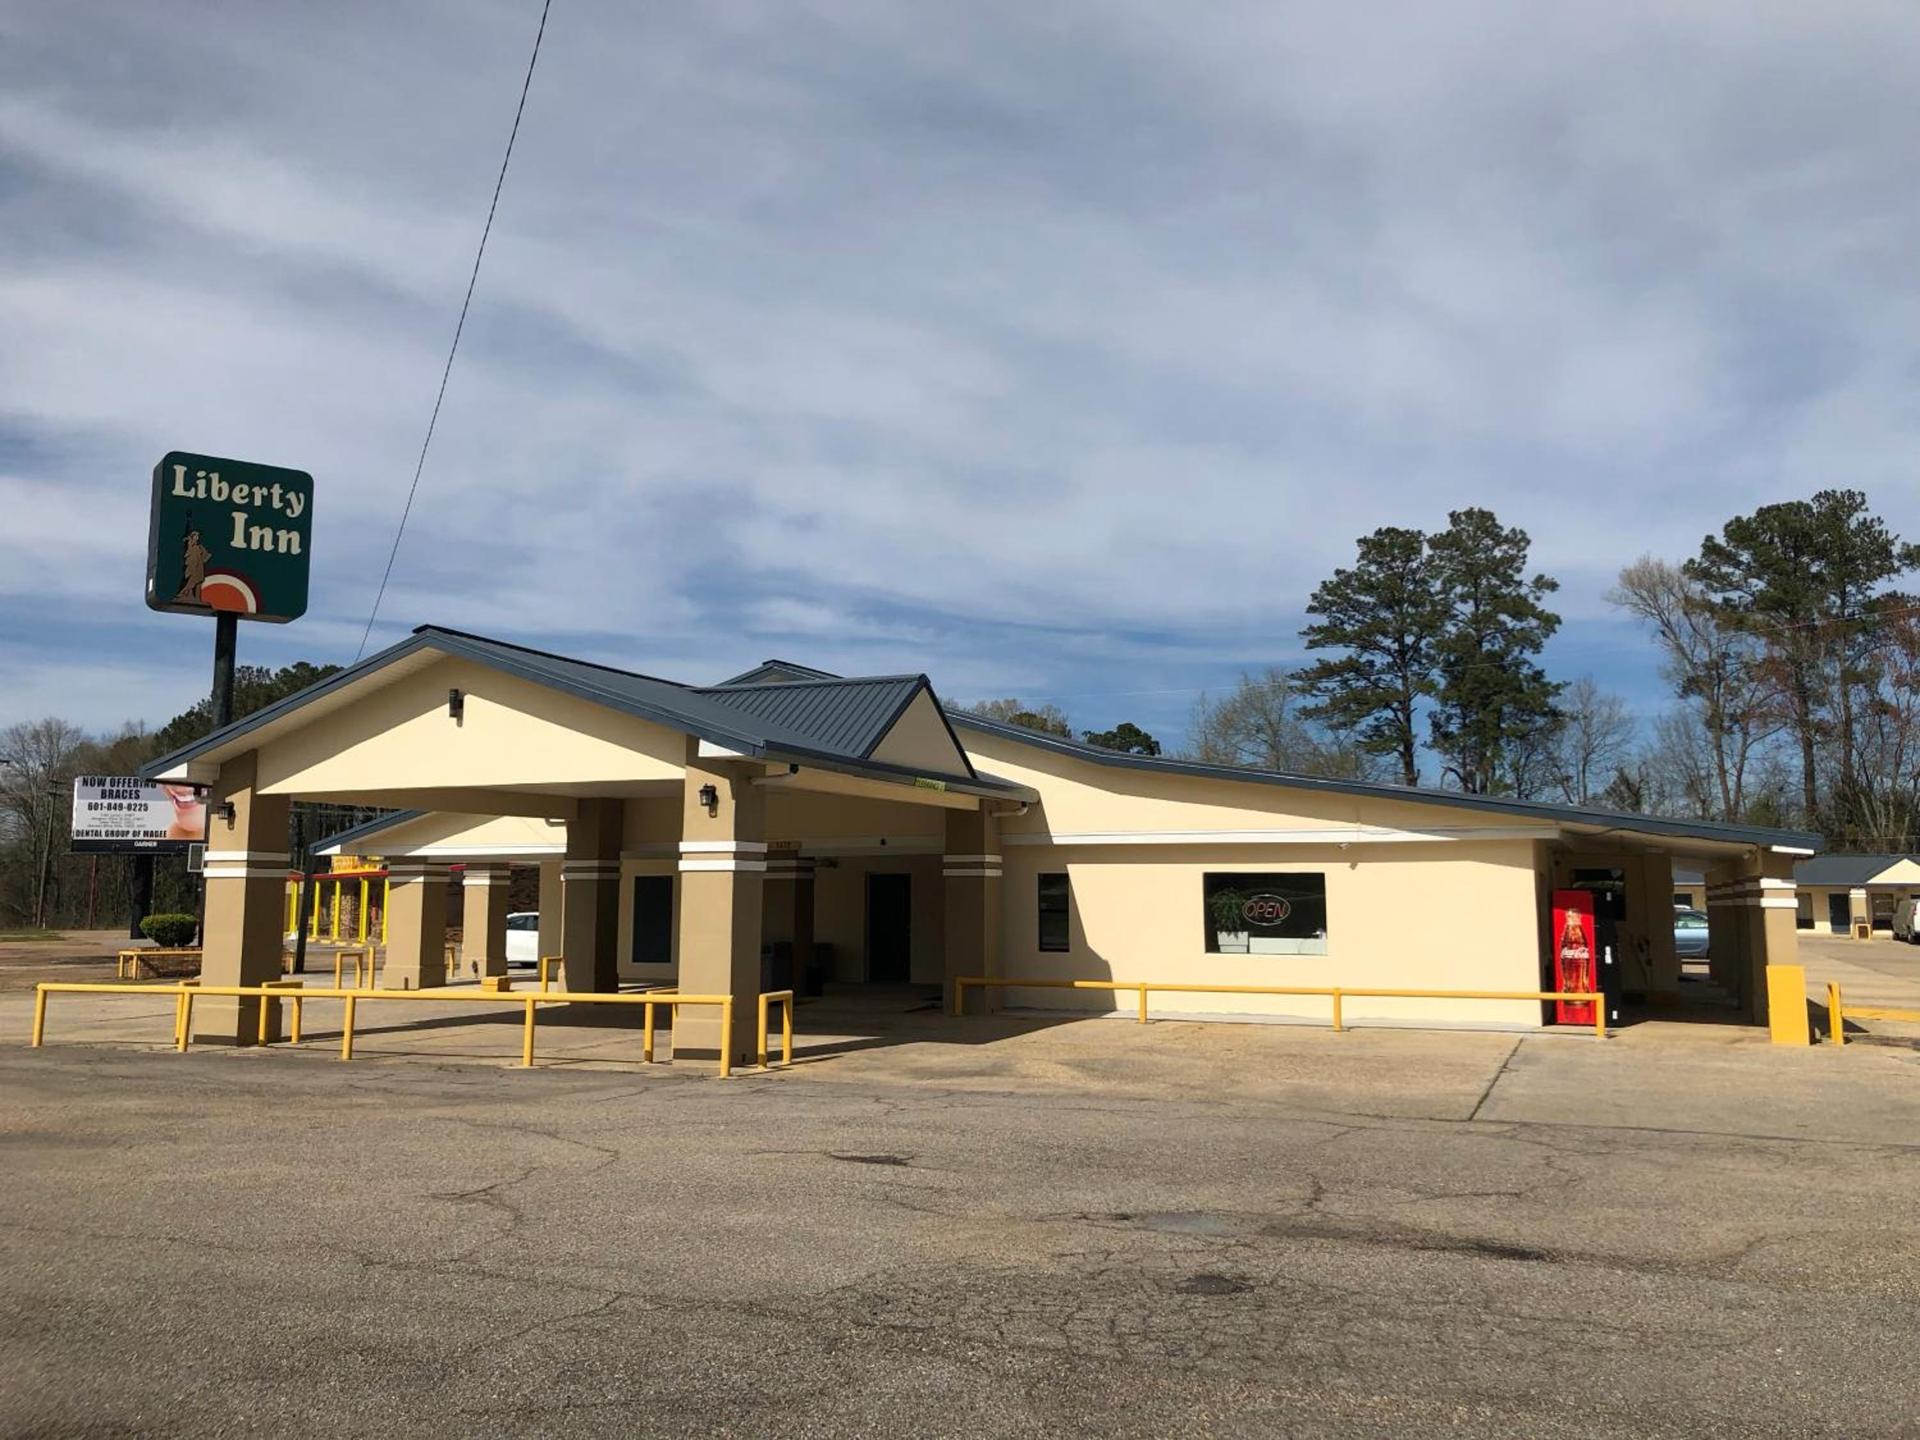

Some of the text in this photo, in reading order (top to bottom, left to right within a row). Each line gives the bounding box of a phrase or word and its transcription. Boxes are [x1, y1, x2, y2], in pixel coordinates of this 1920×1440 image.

[171, 464, 305, 518] Liberty
[230, 511, 302, 555] Inn
[82, 777, 107, 787] NOW
[100, 789, 141, 800] BRACES
[75, 829, 167, 838] DENTAL GROUP OF MAGEE
[1245, 902, 1286, 917] OPEN
